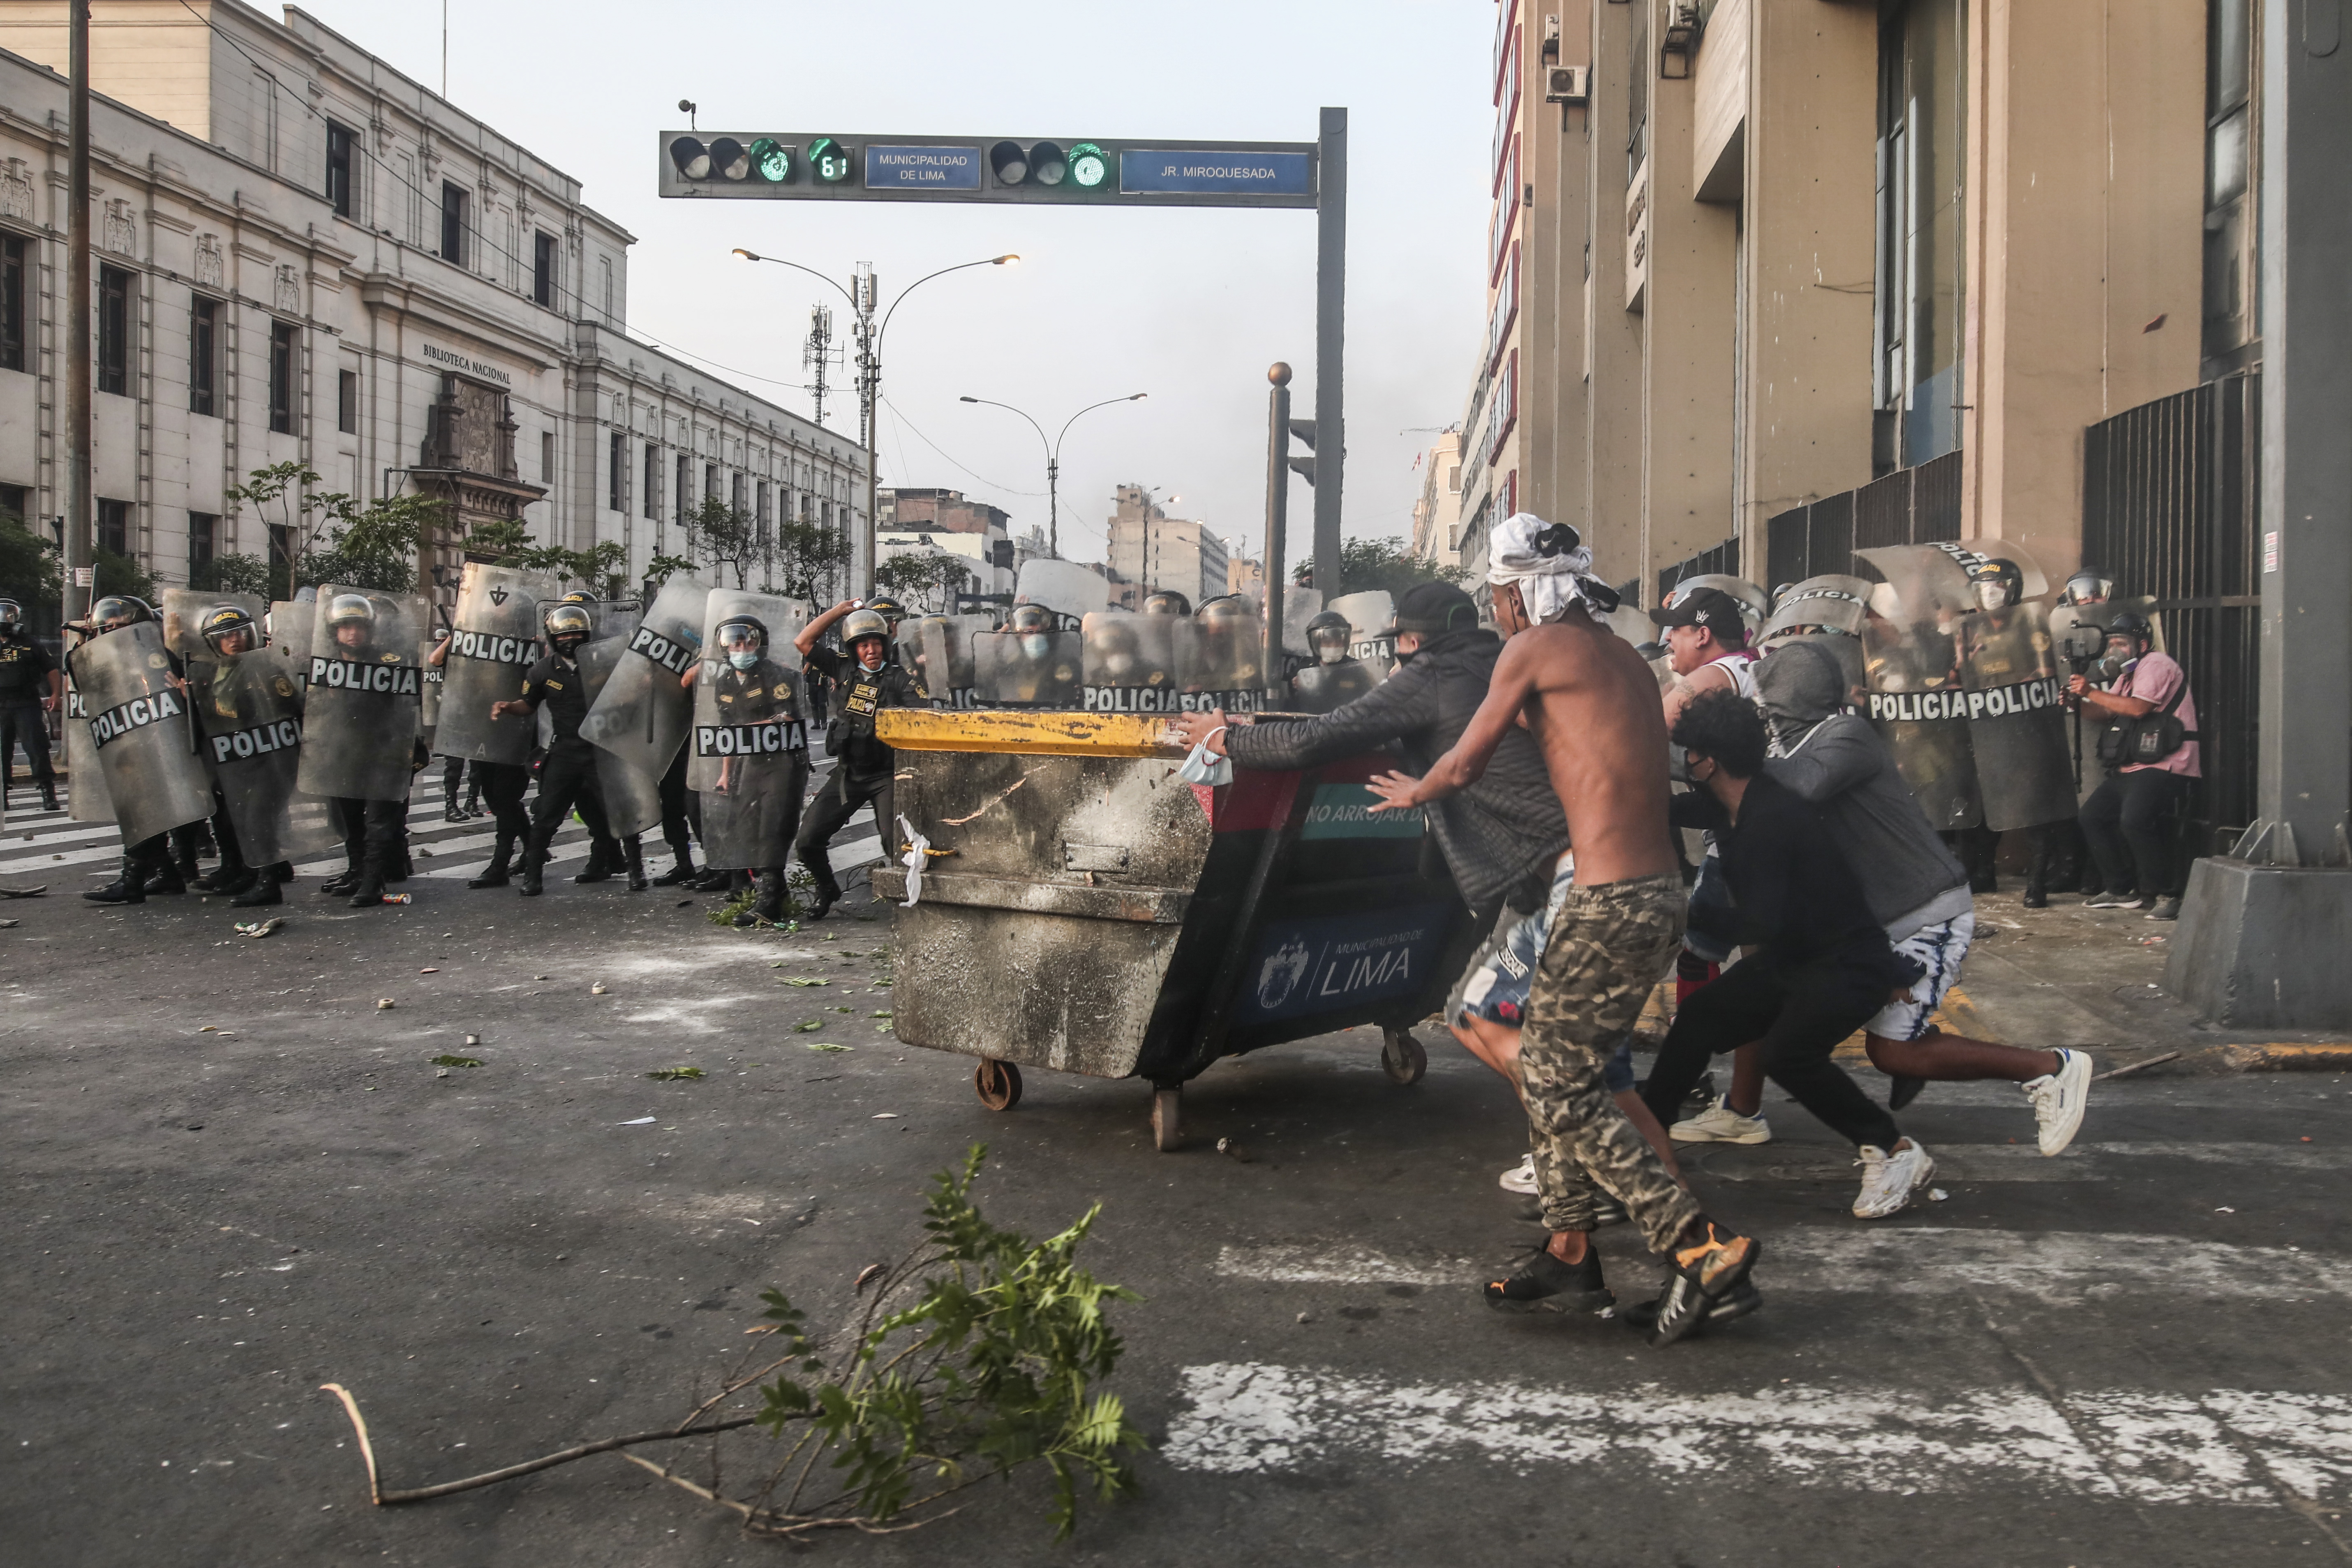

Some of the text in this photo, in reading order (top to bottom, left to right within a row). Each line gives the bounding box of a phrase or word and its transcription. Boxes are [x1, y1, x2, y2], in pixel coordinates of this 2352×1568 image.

[822, 156, 848, 177] 61
[879, 155, 967, 166] MUNICIPALIDAD
[1161, 166, 1275, 178] JR. MIROQUESADA
[900, 170, 945, 180] DE LIMA
[423, 344, 511, 384] BIBLIOTECA NACIONAL
[1772, 590, 1864, 617] POLICIA
[451, 630, 536, 665] POLICIA
[311, 658, 417, 694] POLICIA
[1083, 687, 1178, 711] POLICIA
[1870, 690, 1967, 721] POLICIA
[91, 692, 180, 747] POLICIA
[699, 723, 804, 755] POLICIA
[1305, 805, 1332, 823] NO
[1331, 804, 1407, 824] ARROJAR
[1336, 929, 1424, 954] MUNICIPALIDAD DE
[1320, 947, 1409, 996] LIMA
